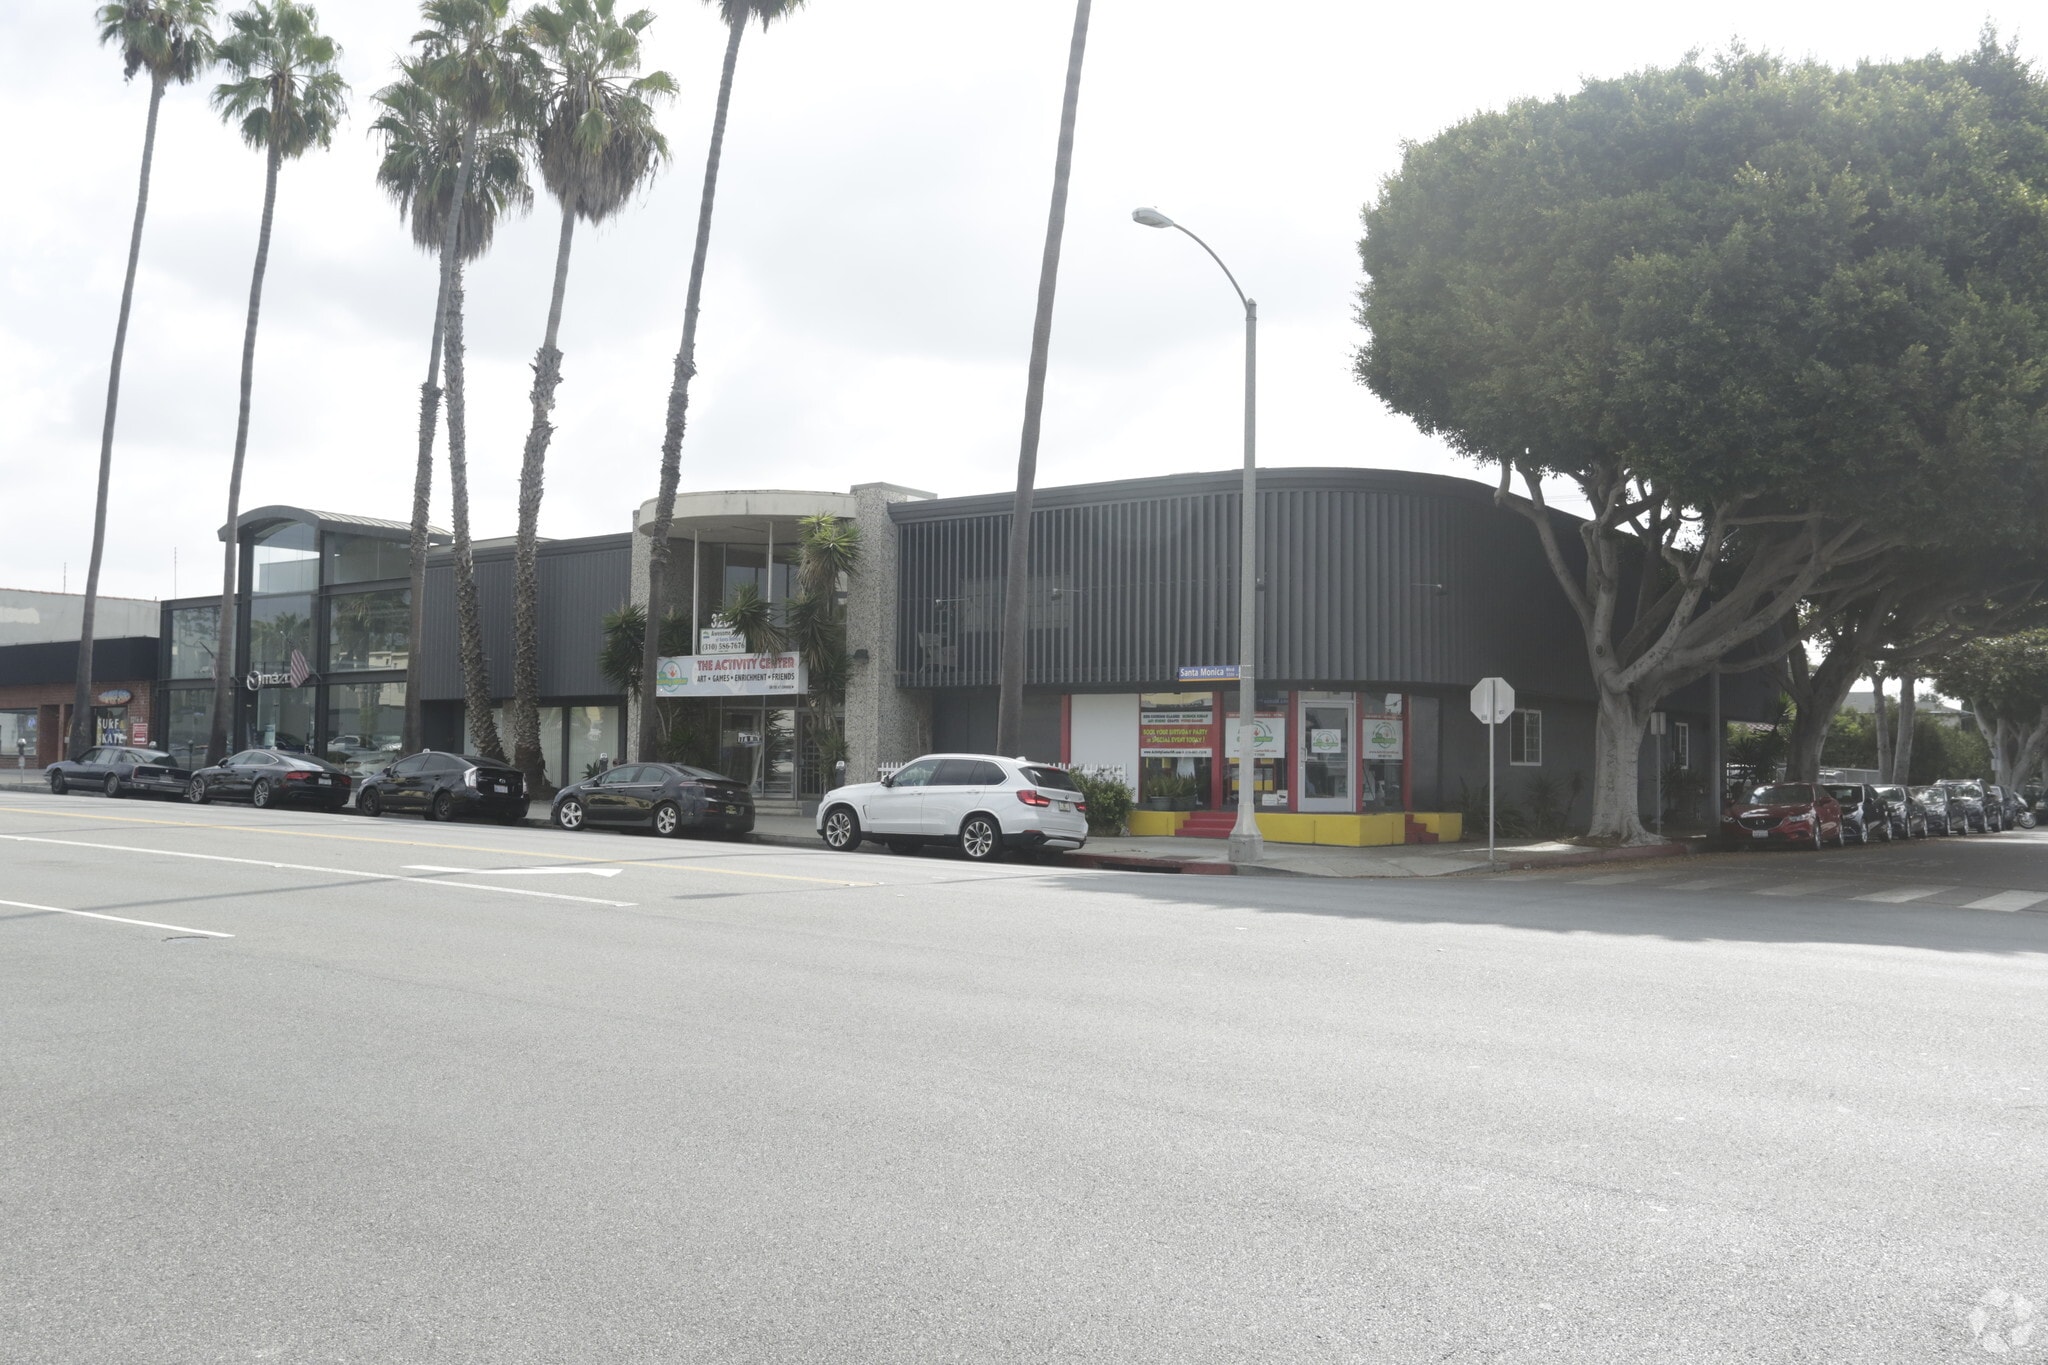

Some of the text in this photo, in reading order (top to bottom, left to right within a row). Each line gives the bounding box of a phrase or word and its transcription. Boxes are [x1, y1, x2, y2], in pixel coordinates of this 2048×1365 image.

[697, 656, 795, 671] THE ACTIVITY CENTER
[697, 675, 707, 683] ART
[712, 674, 730, 683] GAMES
[734, 673, 767, 682] ENRICHMENT
[771, 672, 795, 681] FRIENDS
[1180, 668, 1199, 677] Santa
[1200, 667, 1225, 677] Monica
[97, 718, 120, 730] SURF
